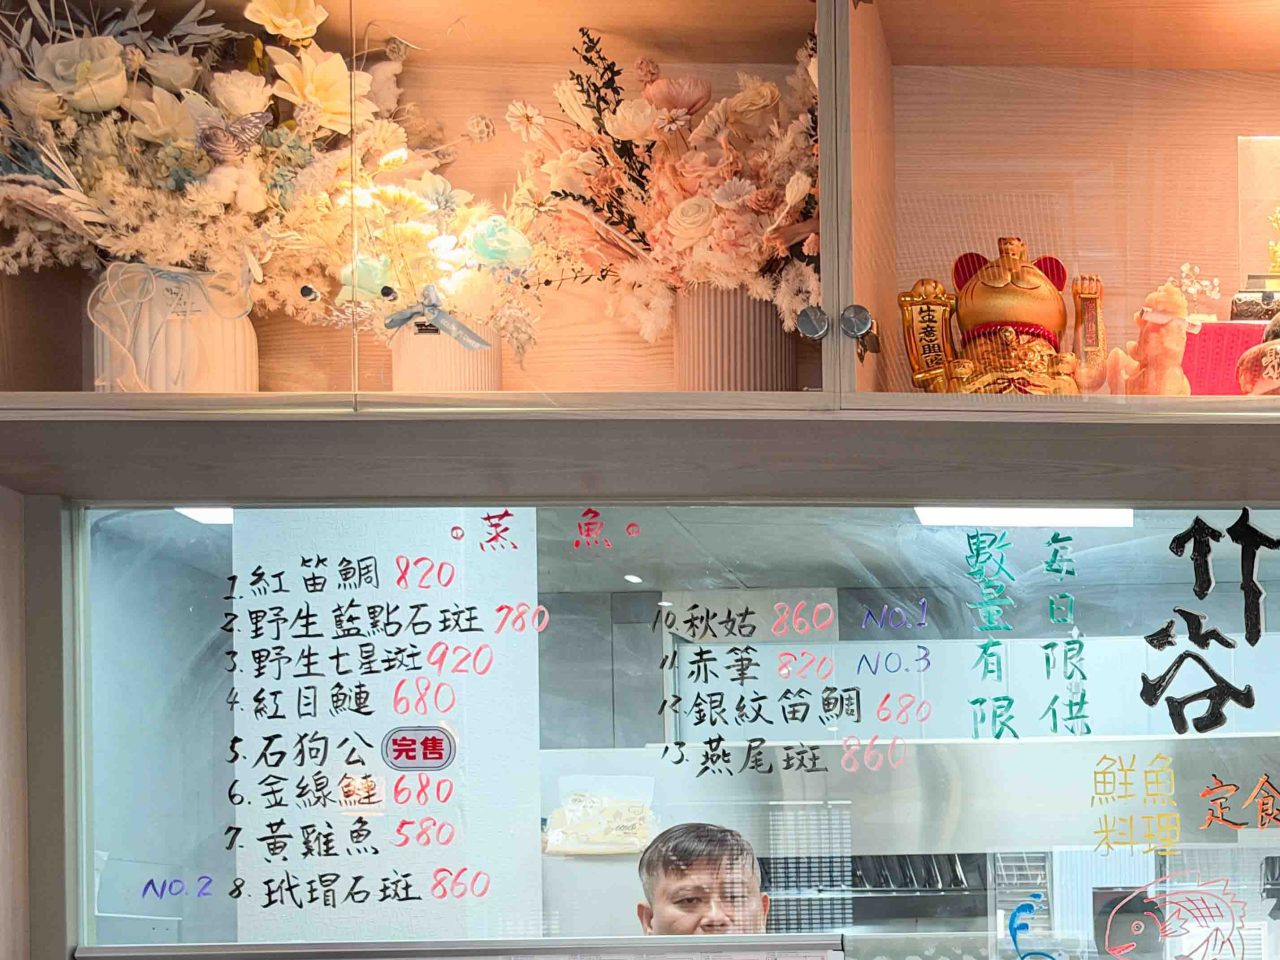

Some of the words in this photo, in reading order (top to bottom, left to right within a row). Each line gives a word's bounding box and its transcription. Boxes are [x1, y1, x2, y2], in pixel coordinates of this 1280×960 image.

[394, 555, 456, 591] 820
[493, 603, 551, 635] 780
[770, 601, 835, 637] 860
[964, 529, 1020, 739] 數量有限
[1038, 531, 1092, 736] 每日限供
[426, 641, 495, 680] 920
[392, 676, 457, 717] 680
[876, 692, 933, 726] 680
[391, 736, 446, 762] 完售
[840, 735, 908, 773] 860
[392, 771, 455, 805] 680
[393, 815, 456, 848] 580
[430, 867, 492, 902] 860
